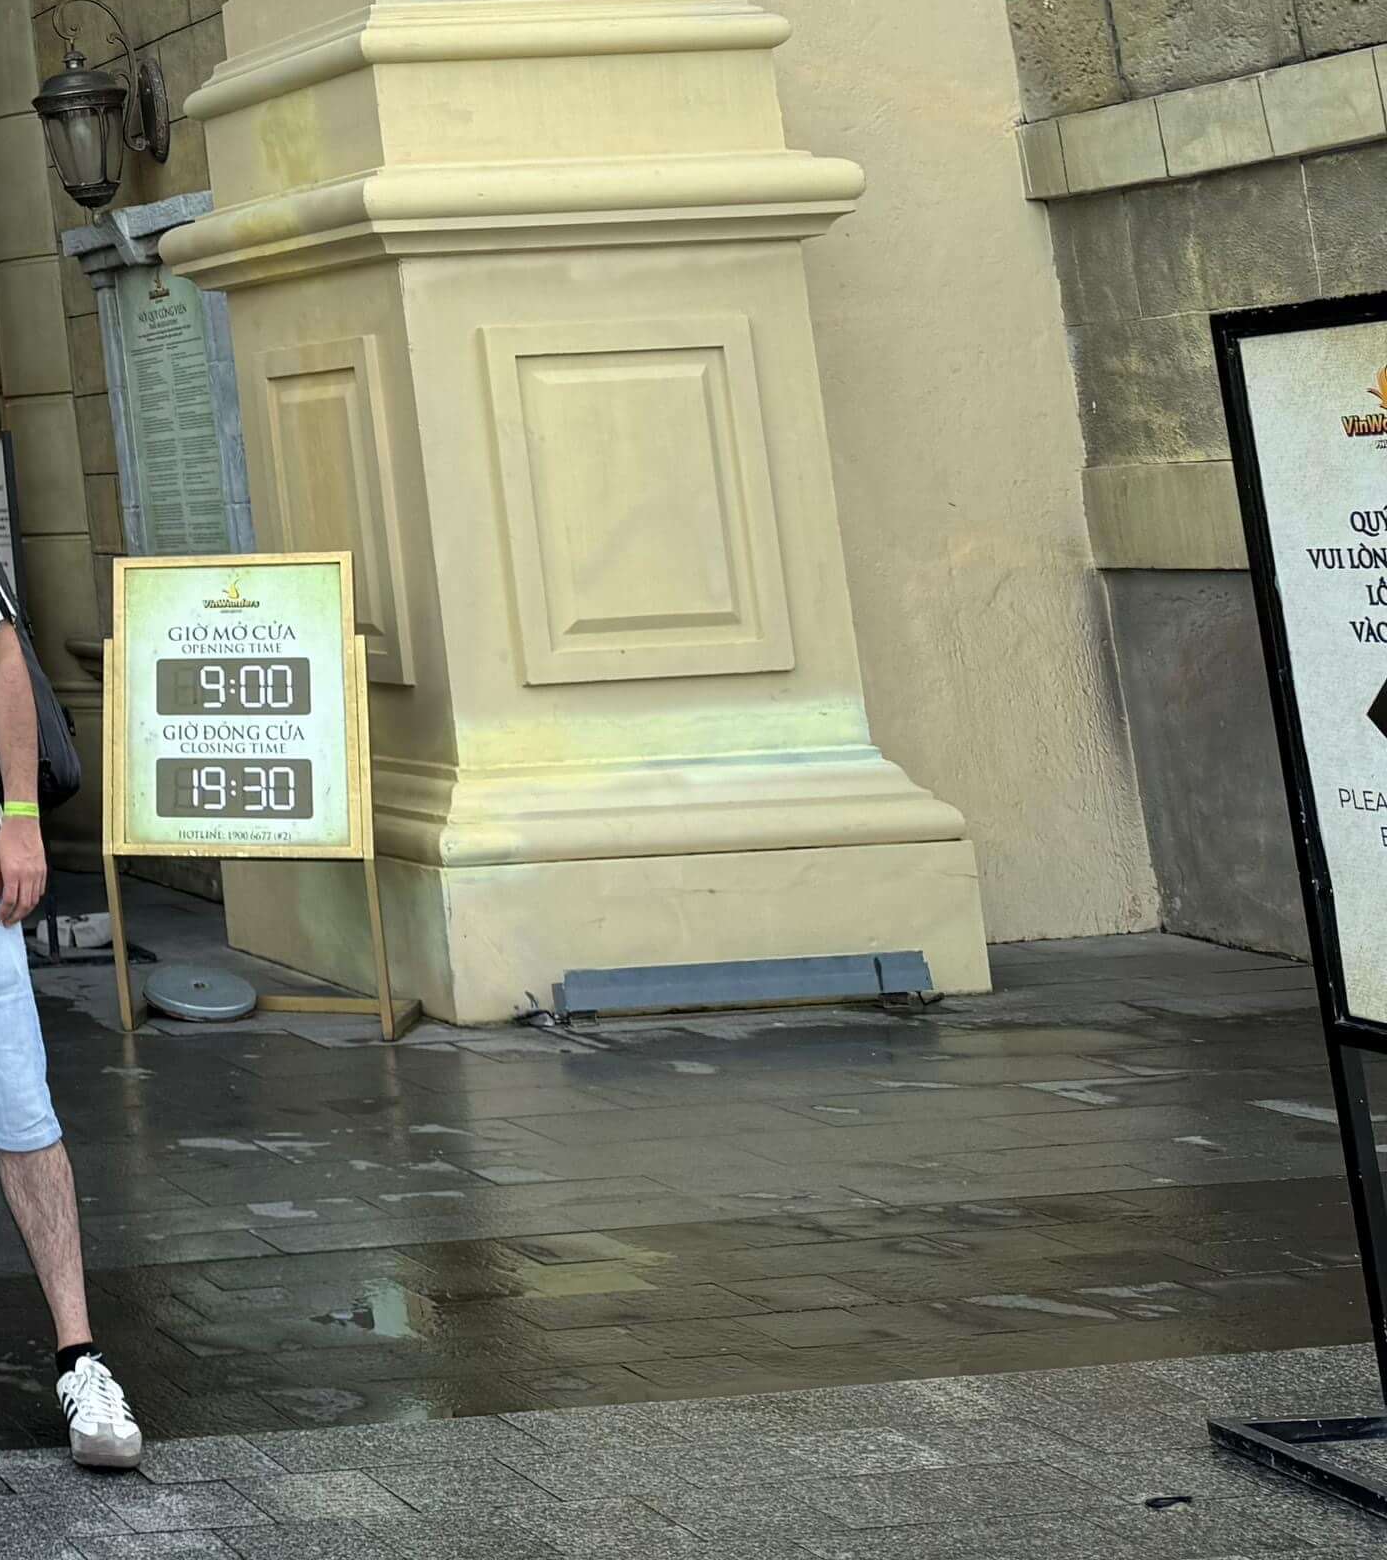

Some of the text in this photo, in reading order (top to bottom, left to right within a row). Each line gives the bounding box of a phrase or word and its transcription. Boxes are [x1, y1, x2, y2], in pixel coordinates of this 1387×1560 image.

[1306, 547, 1345, 570] VUI
[168, 620, 296, 641] GIỜ MỞ CỬA
[181, 642, 283, 655] OPENING TIME
[200, 664, 293, 708] 9:00
[163, 721, 198, 741] GIỜ
[265, 720, 305, 741] CỬA
[180, 742, 287, 754] CLOSING TIME
[192, 766, 295, 811] 19:30
